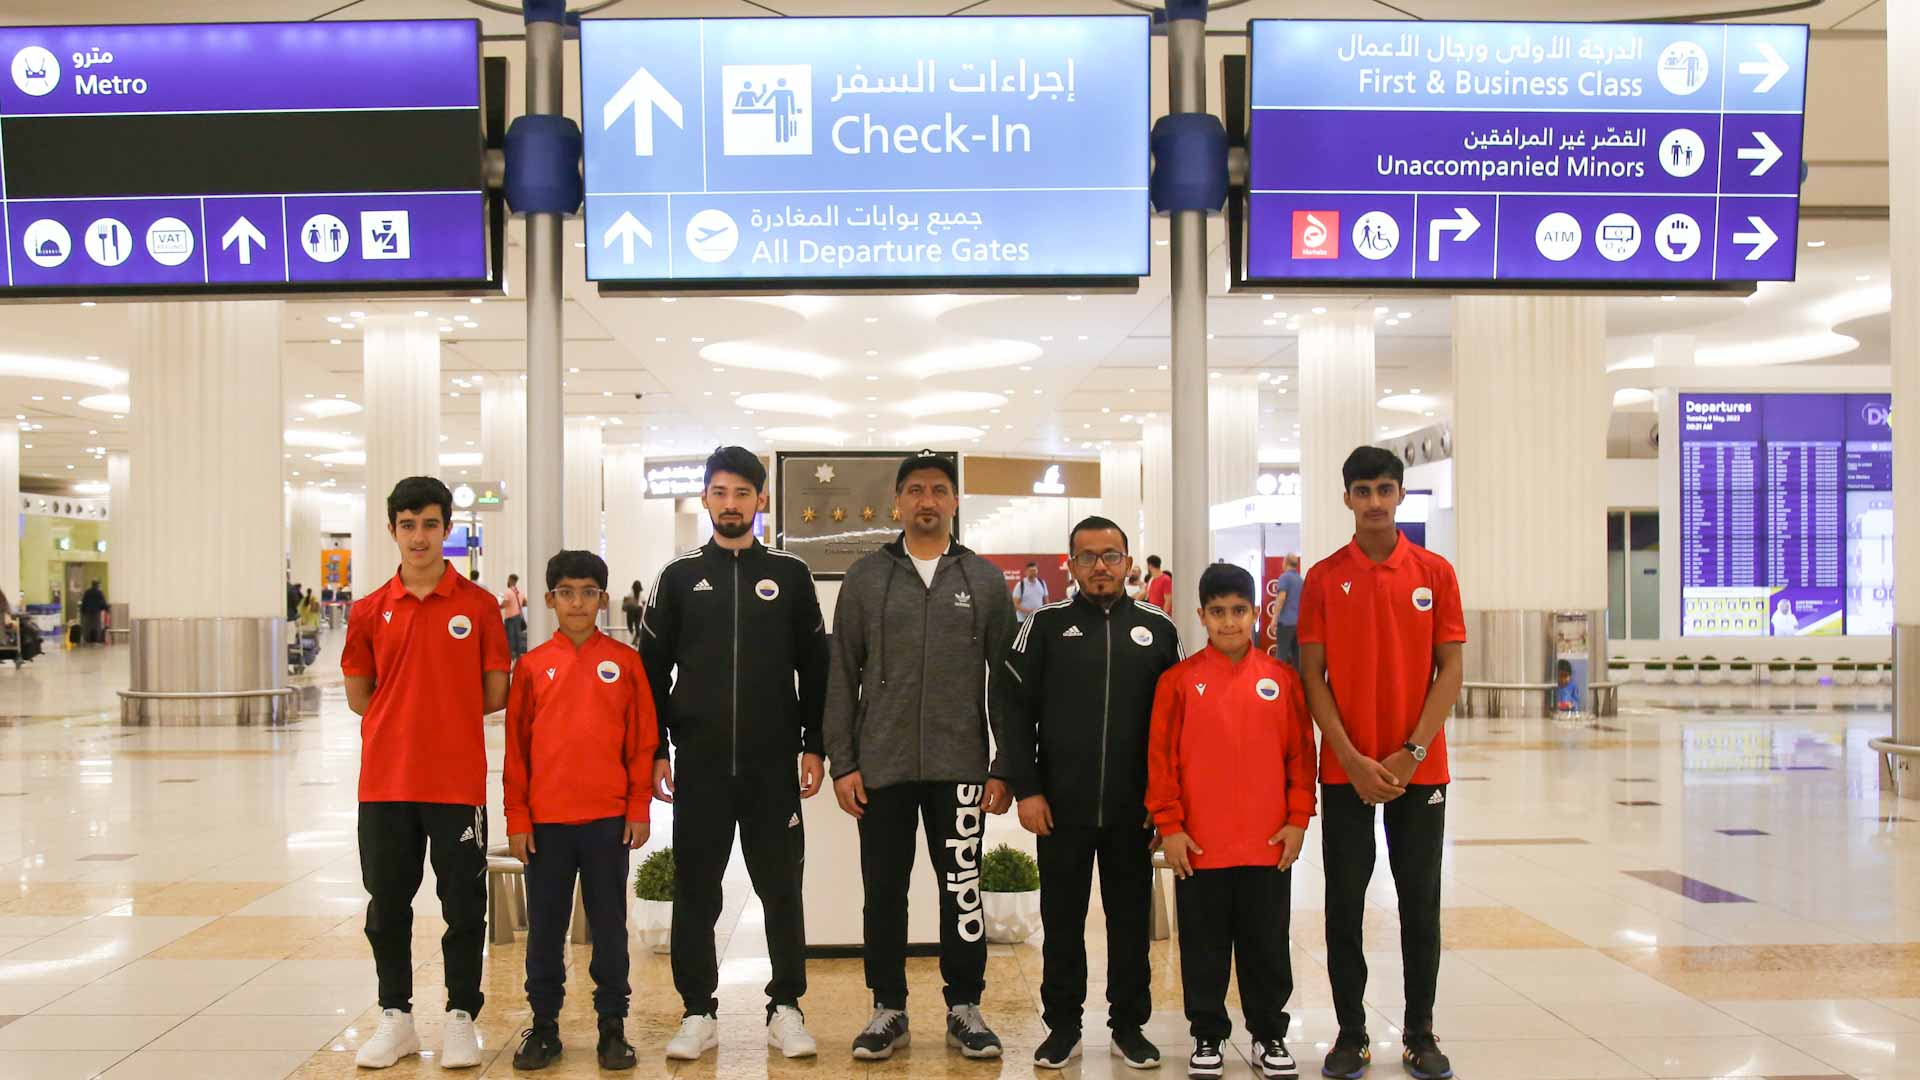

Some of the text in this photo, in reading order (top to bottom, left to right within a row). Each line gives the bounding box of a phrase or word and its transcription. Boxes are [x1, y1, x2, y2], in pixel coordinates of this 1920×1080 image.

[73, 47, 113, 68] مترو
[1427, 34, 1488, 63] ورجال
[1579, 36, 1644, 65] الدرجة
[75, 75, 148, 96] Metro
[831, 57, 1075, 102] إجراءات السفر
[1359, 68, 1643, 97] First & Business Class
[831, 112, 1032, 155] Check-In
[1463, 128, 1554, 150] المرافقين
[1558, 130, 1586, 151] غير
[1377, 155, 1645, 181] Unaccompanied Minors
[750, 204, 983, 236] جميع بوابات المغادرة
[158, 233, 180, 243] VAT
[1543, 231, 1575, 242] ATM
[751, 238, 1030, 269] All Departure Gates
[1686, 401, 1752, 415] Departures
[946, 784, 984, 942] adidas
